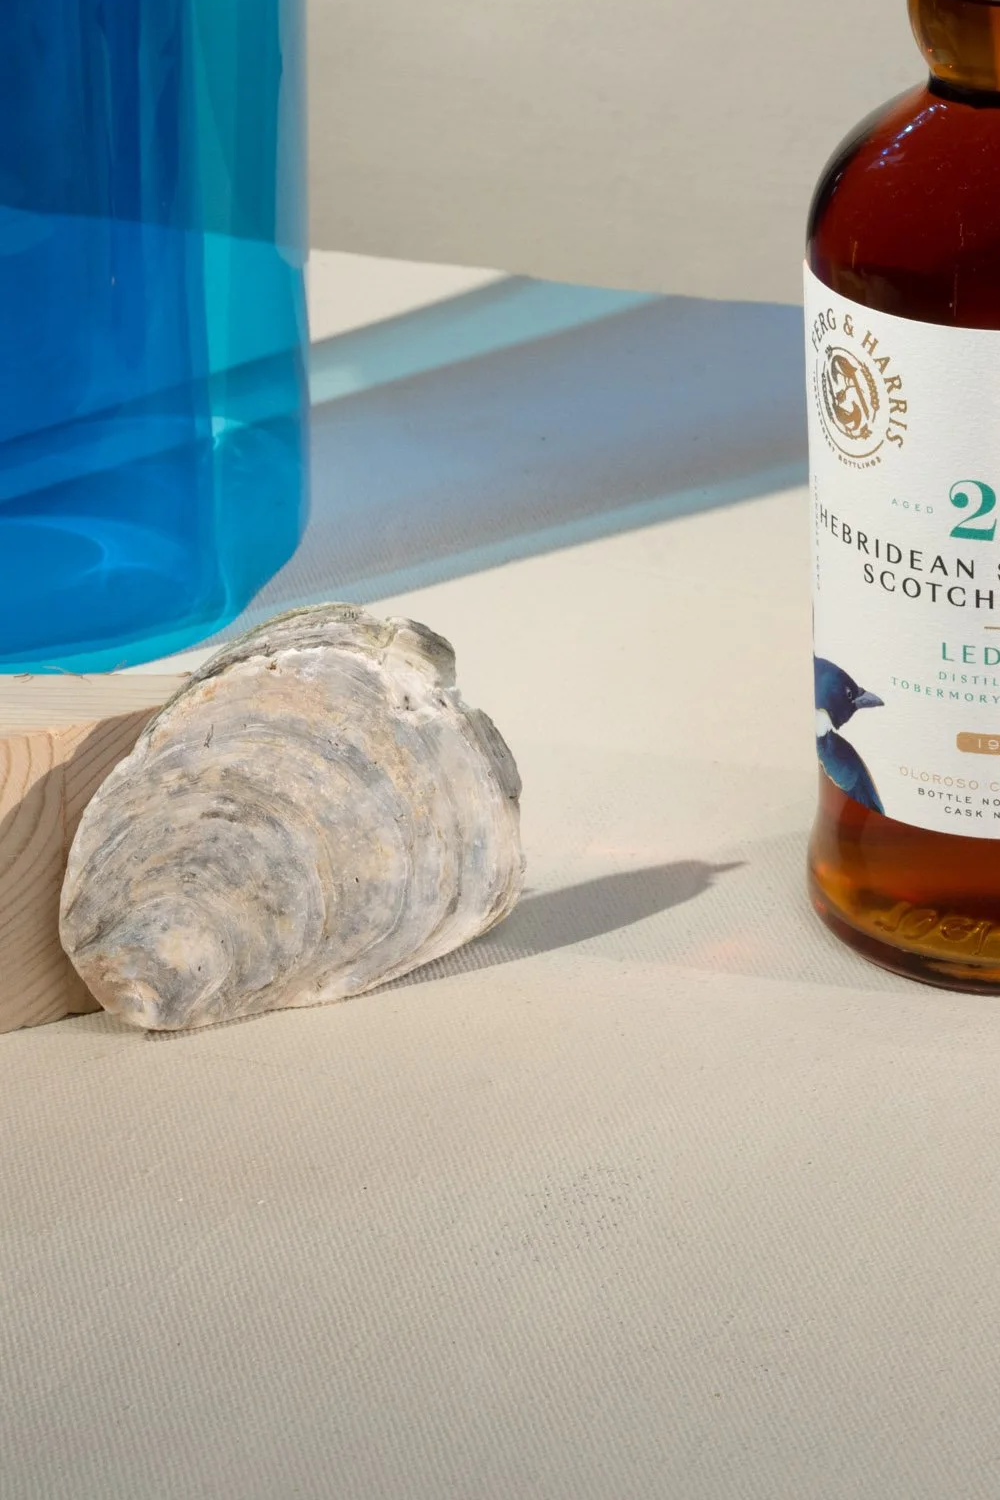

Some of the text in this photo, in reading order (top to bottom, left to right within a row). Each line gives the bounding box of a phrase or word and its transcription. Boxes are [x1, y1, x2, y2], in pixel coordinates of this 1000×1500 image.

[811, 307, 908, 448] FERG & HARRIS
[891, 497, 934, 514] AGED
[819, 503, 975, 580] HEBRIDEAN
[863, 563, 994, 610] SCOTCH
[890, 675, 1000, 705] TOBERMORY
[899, 765, 980, 791] OLOROSO
[917, 787, 972, 805] BOTTLE
[944, 806, 983, 819] CASK
